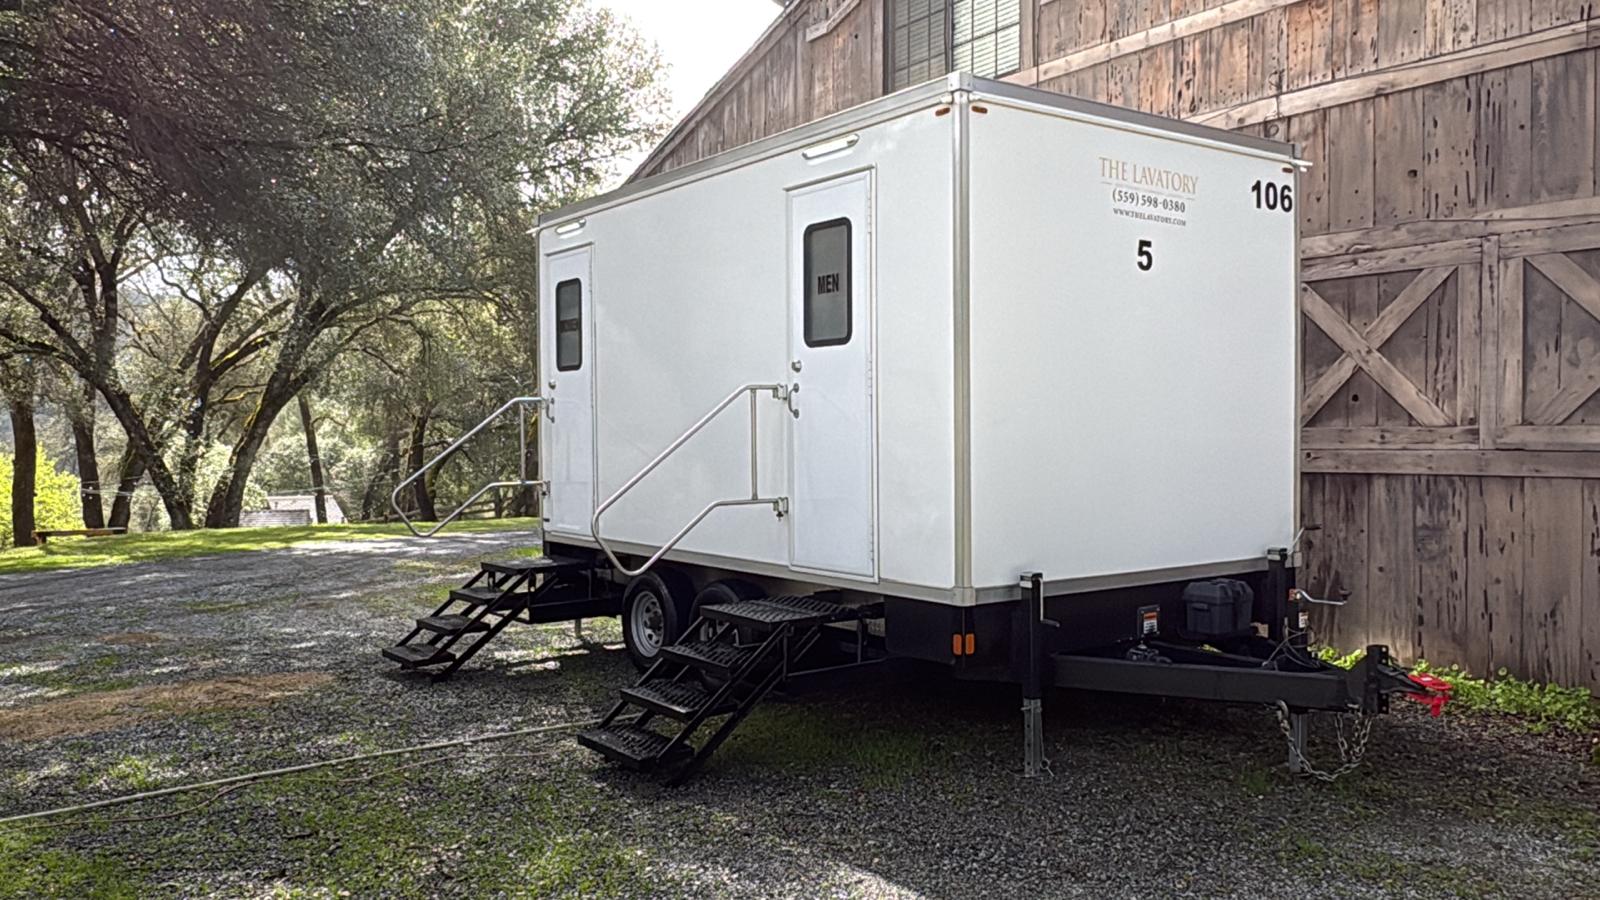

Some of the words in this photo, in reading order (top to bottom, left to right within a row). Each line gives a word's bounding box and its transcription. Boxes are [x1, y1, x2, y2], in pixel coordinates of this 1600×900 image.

[1099, 157, 1128, 181] THE
[1133, 164, 1199, 195] LAVATORY
[1251, 180, 1293, 213] 106
[1137, 240, 1153, 271] 5
[817, 272, 840, 295] MEN
